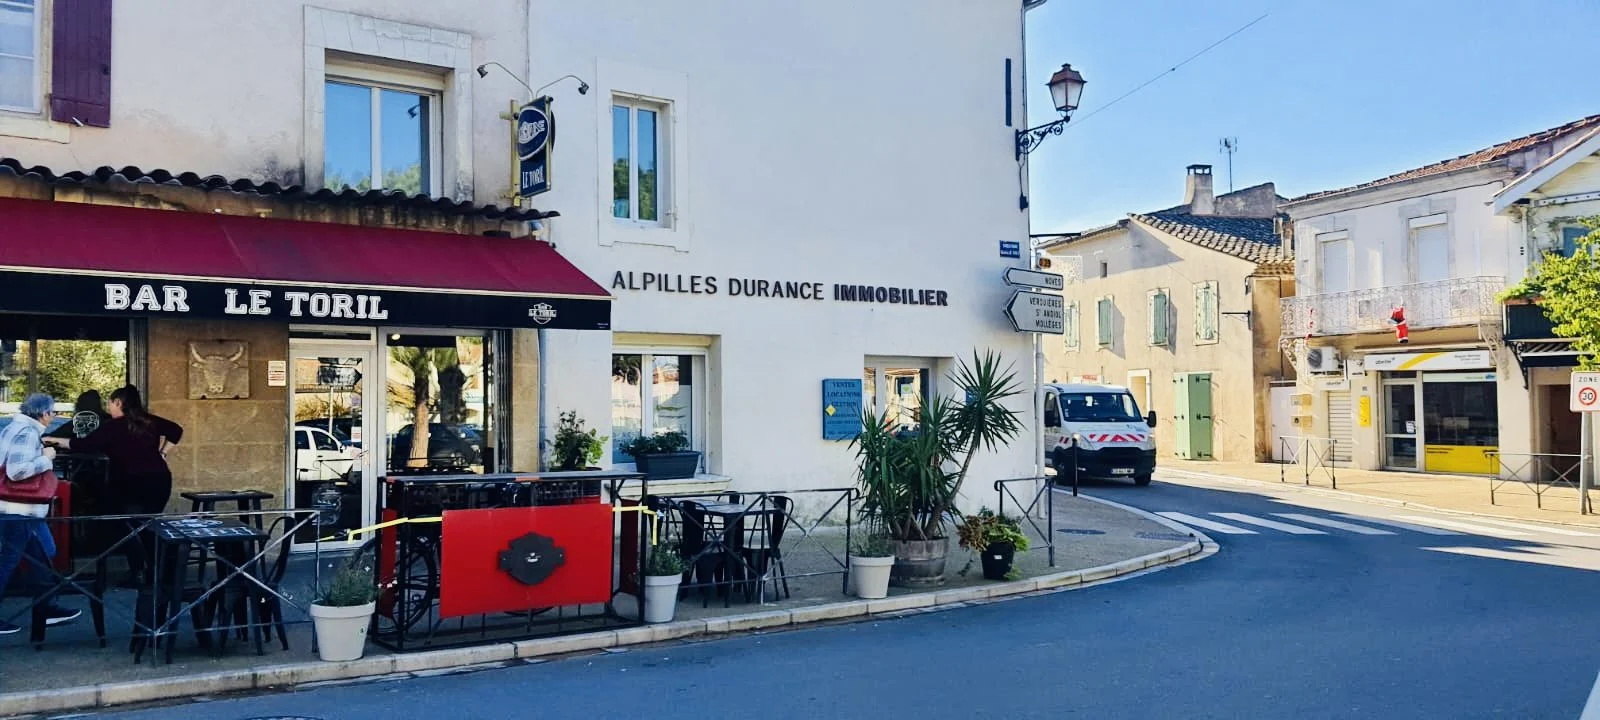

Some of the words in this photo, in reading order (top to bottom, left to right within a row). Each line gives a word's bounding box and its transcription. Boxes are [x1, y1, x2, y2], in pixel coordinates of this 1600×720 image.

[522, 171, 528, 189] LE
[612, 270, 718, 295] ALPILLES
[728, 277, 825, 300] DURANCE
[833, 283, 949, 307] IMMOBILIER
[1044, 277, 1062, 286] NOVES
[104, 283, 190, 312] BAR
[224, 288, 272, 316] LE
[285, 291, 388, 320] TORIL
[1582, 392, 1594, 401] 30
